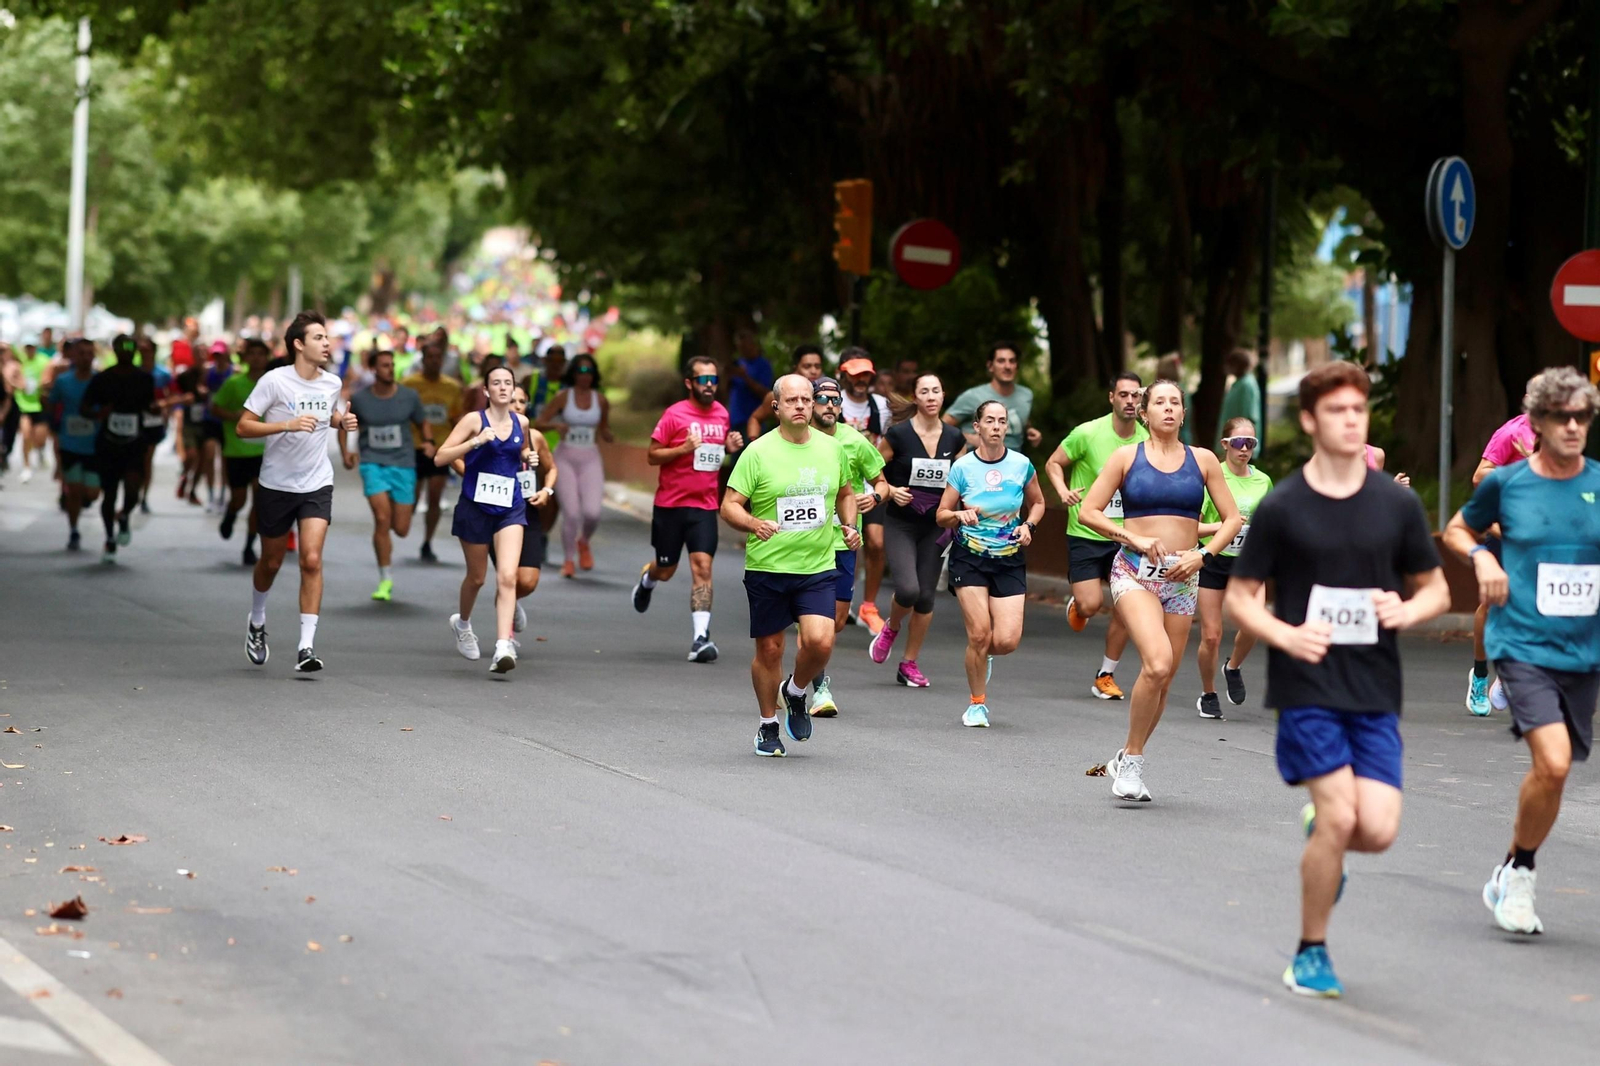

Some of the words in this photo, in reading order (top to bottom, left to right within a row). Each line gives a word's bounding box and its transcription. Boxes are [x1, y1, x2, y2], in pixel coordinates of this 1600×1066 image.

[299, 401, 327, 410] 1112
[700, 452, 720, 464] 566
[916, 468, 944, 480] 639
[481, 483, 508, 496] 1111
[784, 507, 817, 521] 226
[1546, 582, 1593, 597] 1037
[1320, 607, 1367, 626] 502
